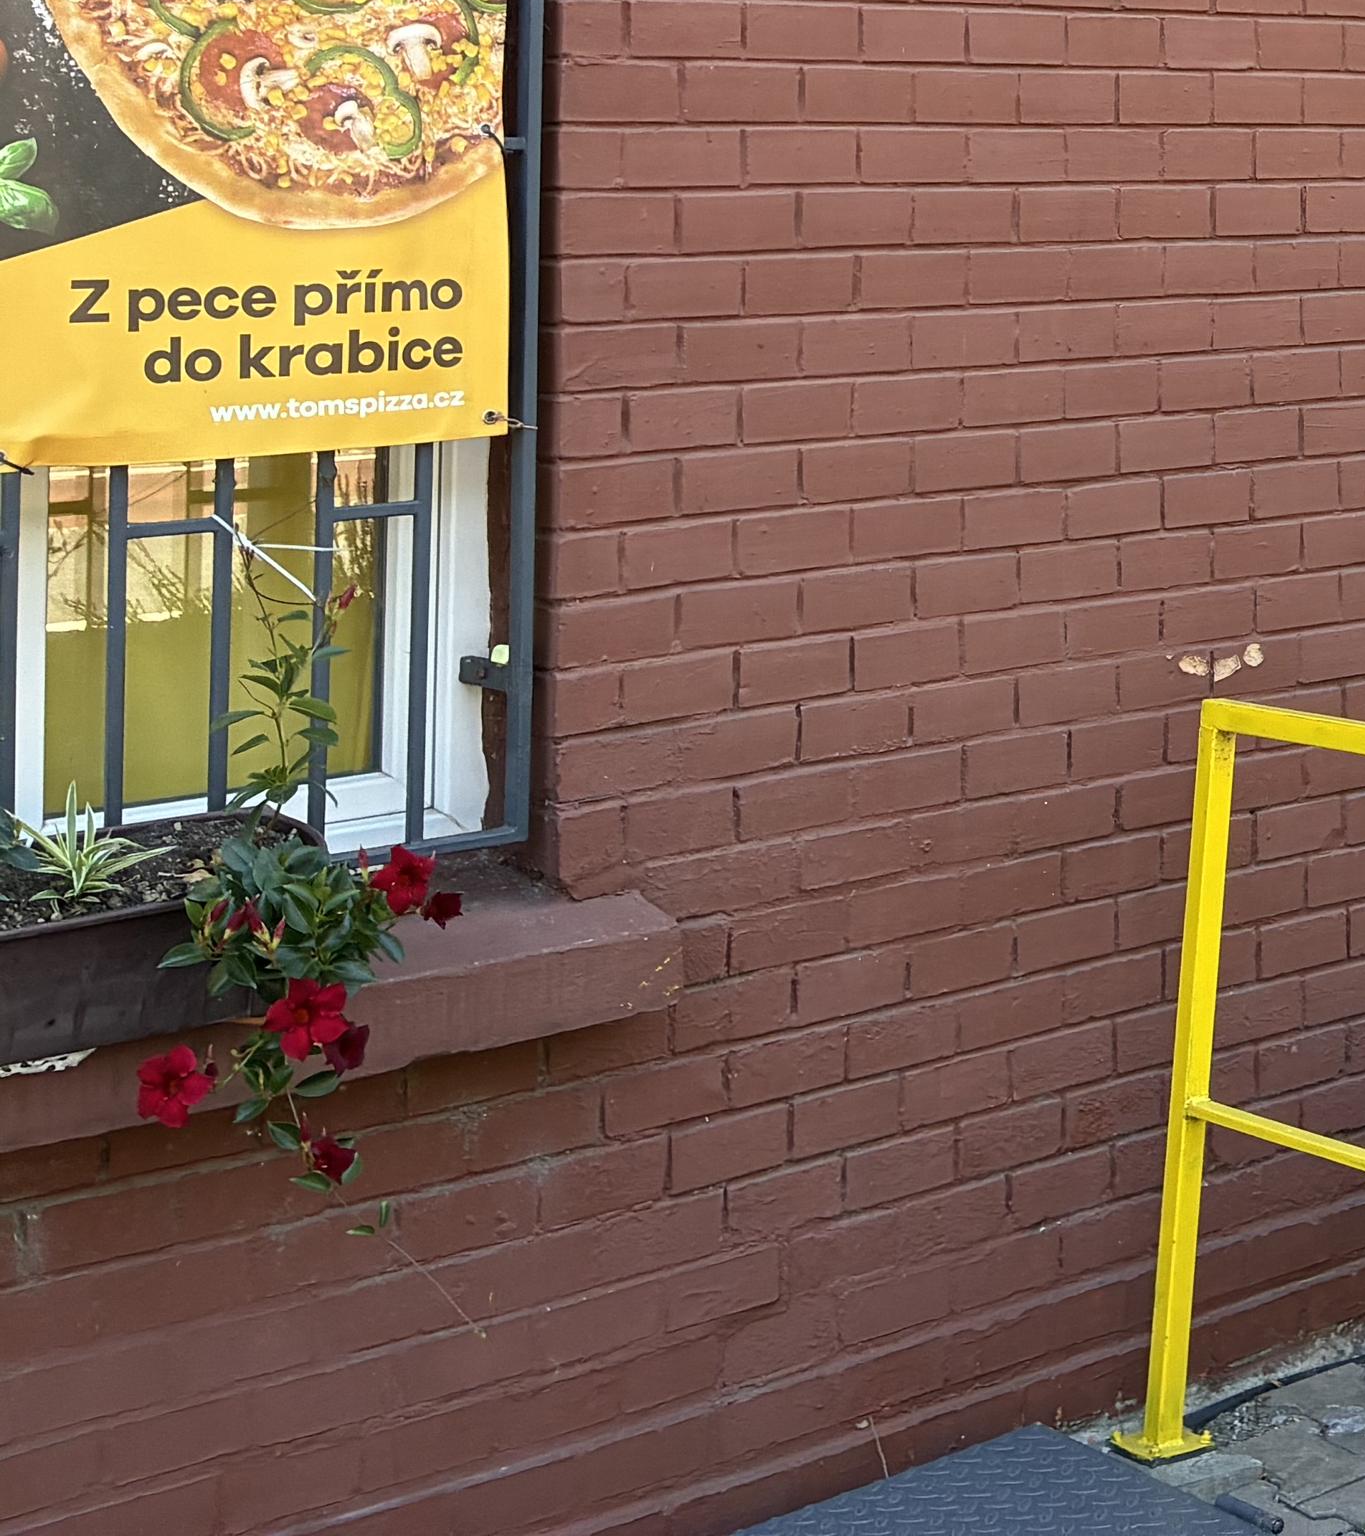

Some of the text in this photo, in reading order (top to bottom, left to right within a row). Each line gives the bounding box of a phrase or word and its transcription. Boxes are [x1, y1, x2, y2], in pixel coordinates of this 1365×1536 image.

[69, 268, 464, 332] Z pece přímo
[144, 326, 463, 384] do krabice
[210, 389, 465, 424] www.tomspizza.cz
